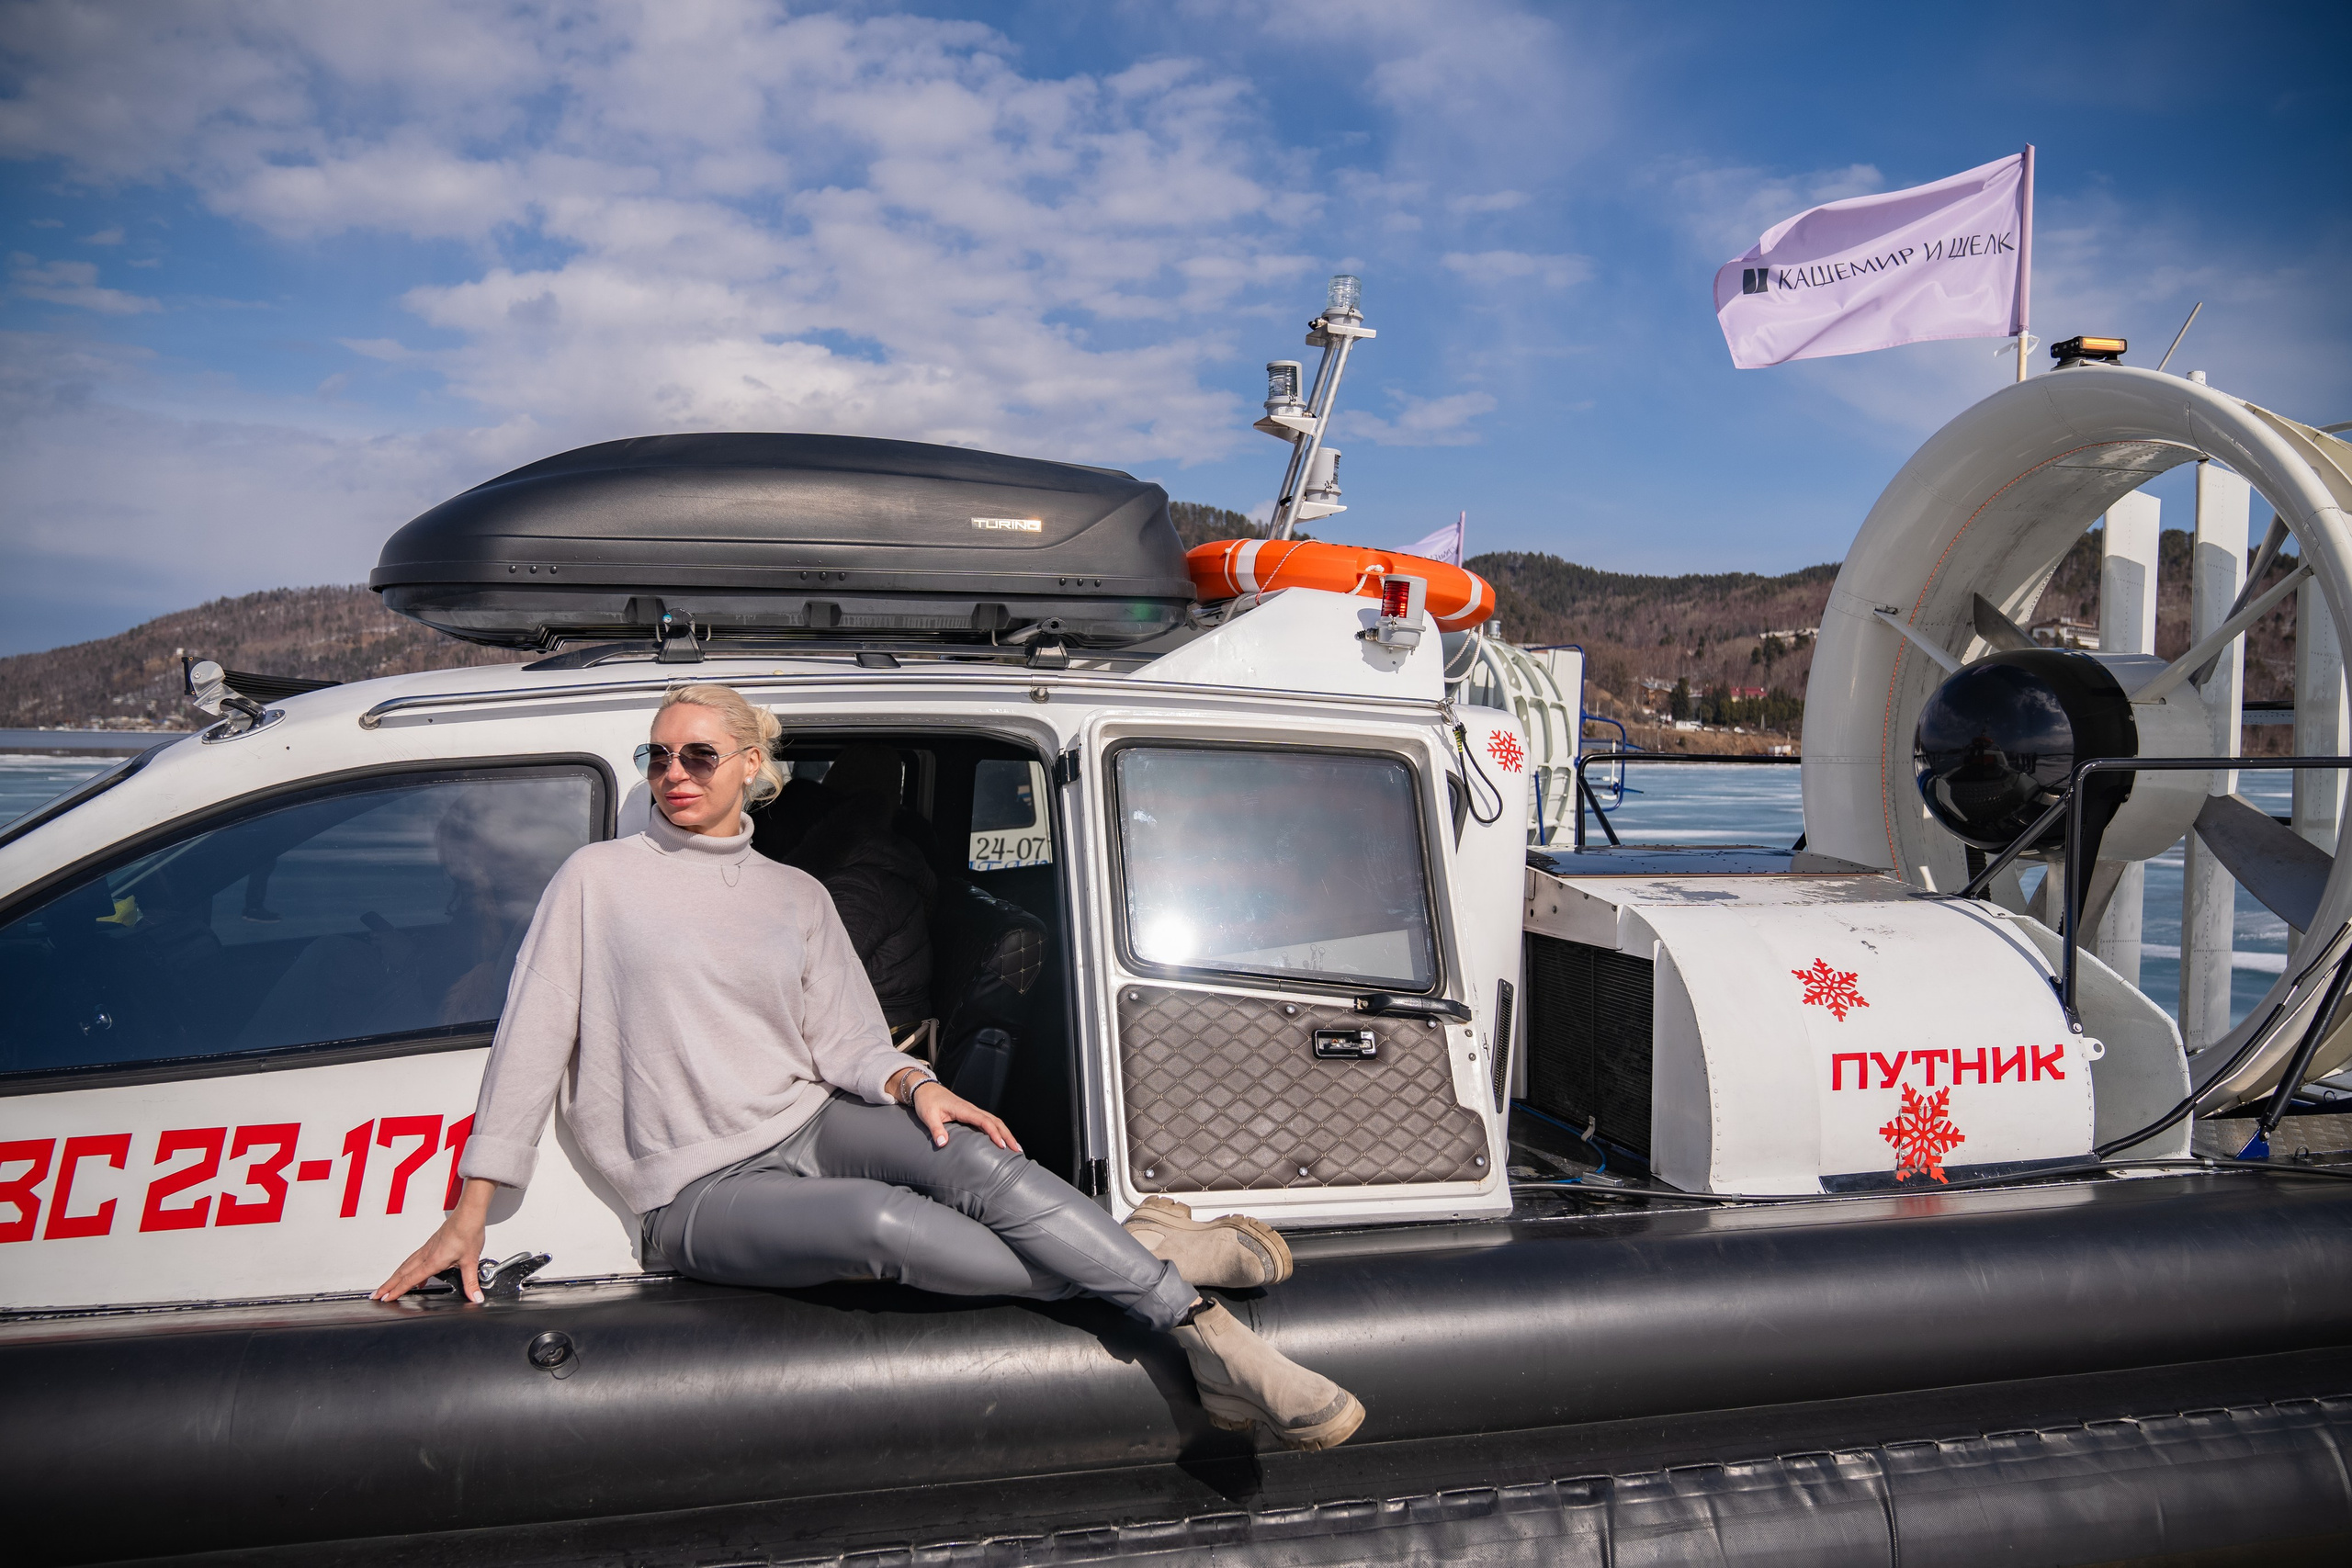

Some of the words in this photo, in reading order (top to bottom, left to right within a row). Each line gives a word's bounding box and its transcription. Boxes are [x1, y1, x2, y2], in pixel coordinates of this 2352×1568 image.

[1778, 247, 1914, 290] КАШЕМИР
[1923, 240, 1942, 262] И
[1948, 231, 2015, 260] ШЕЛК
[976, 837, 1046, 860] 24-07
[1832, 1043, 2065, 1090] ПУТНИК
